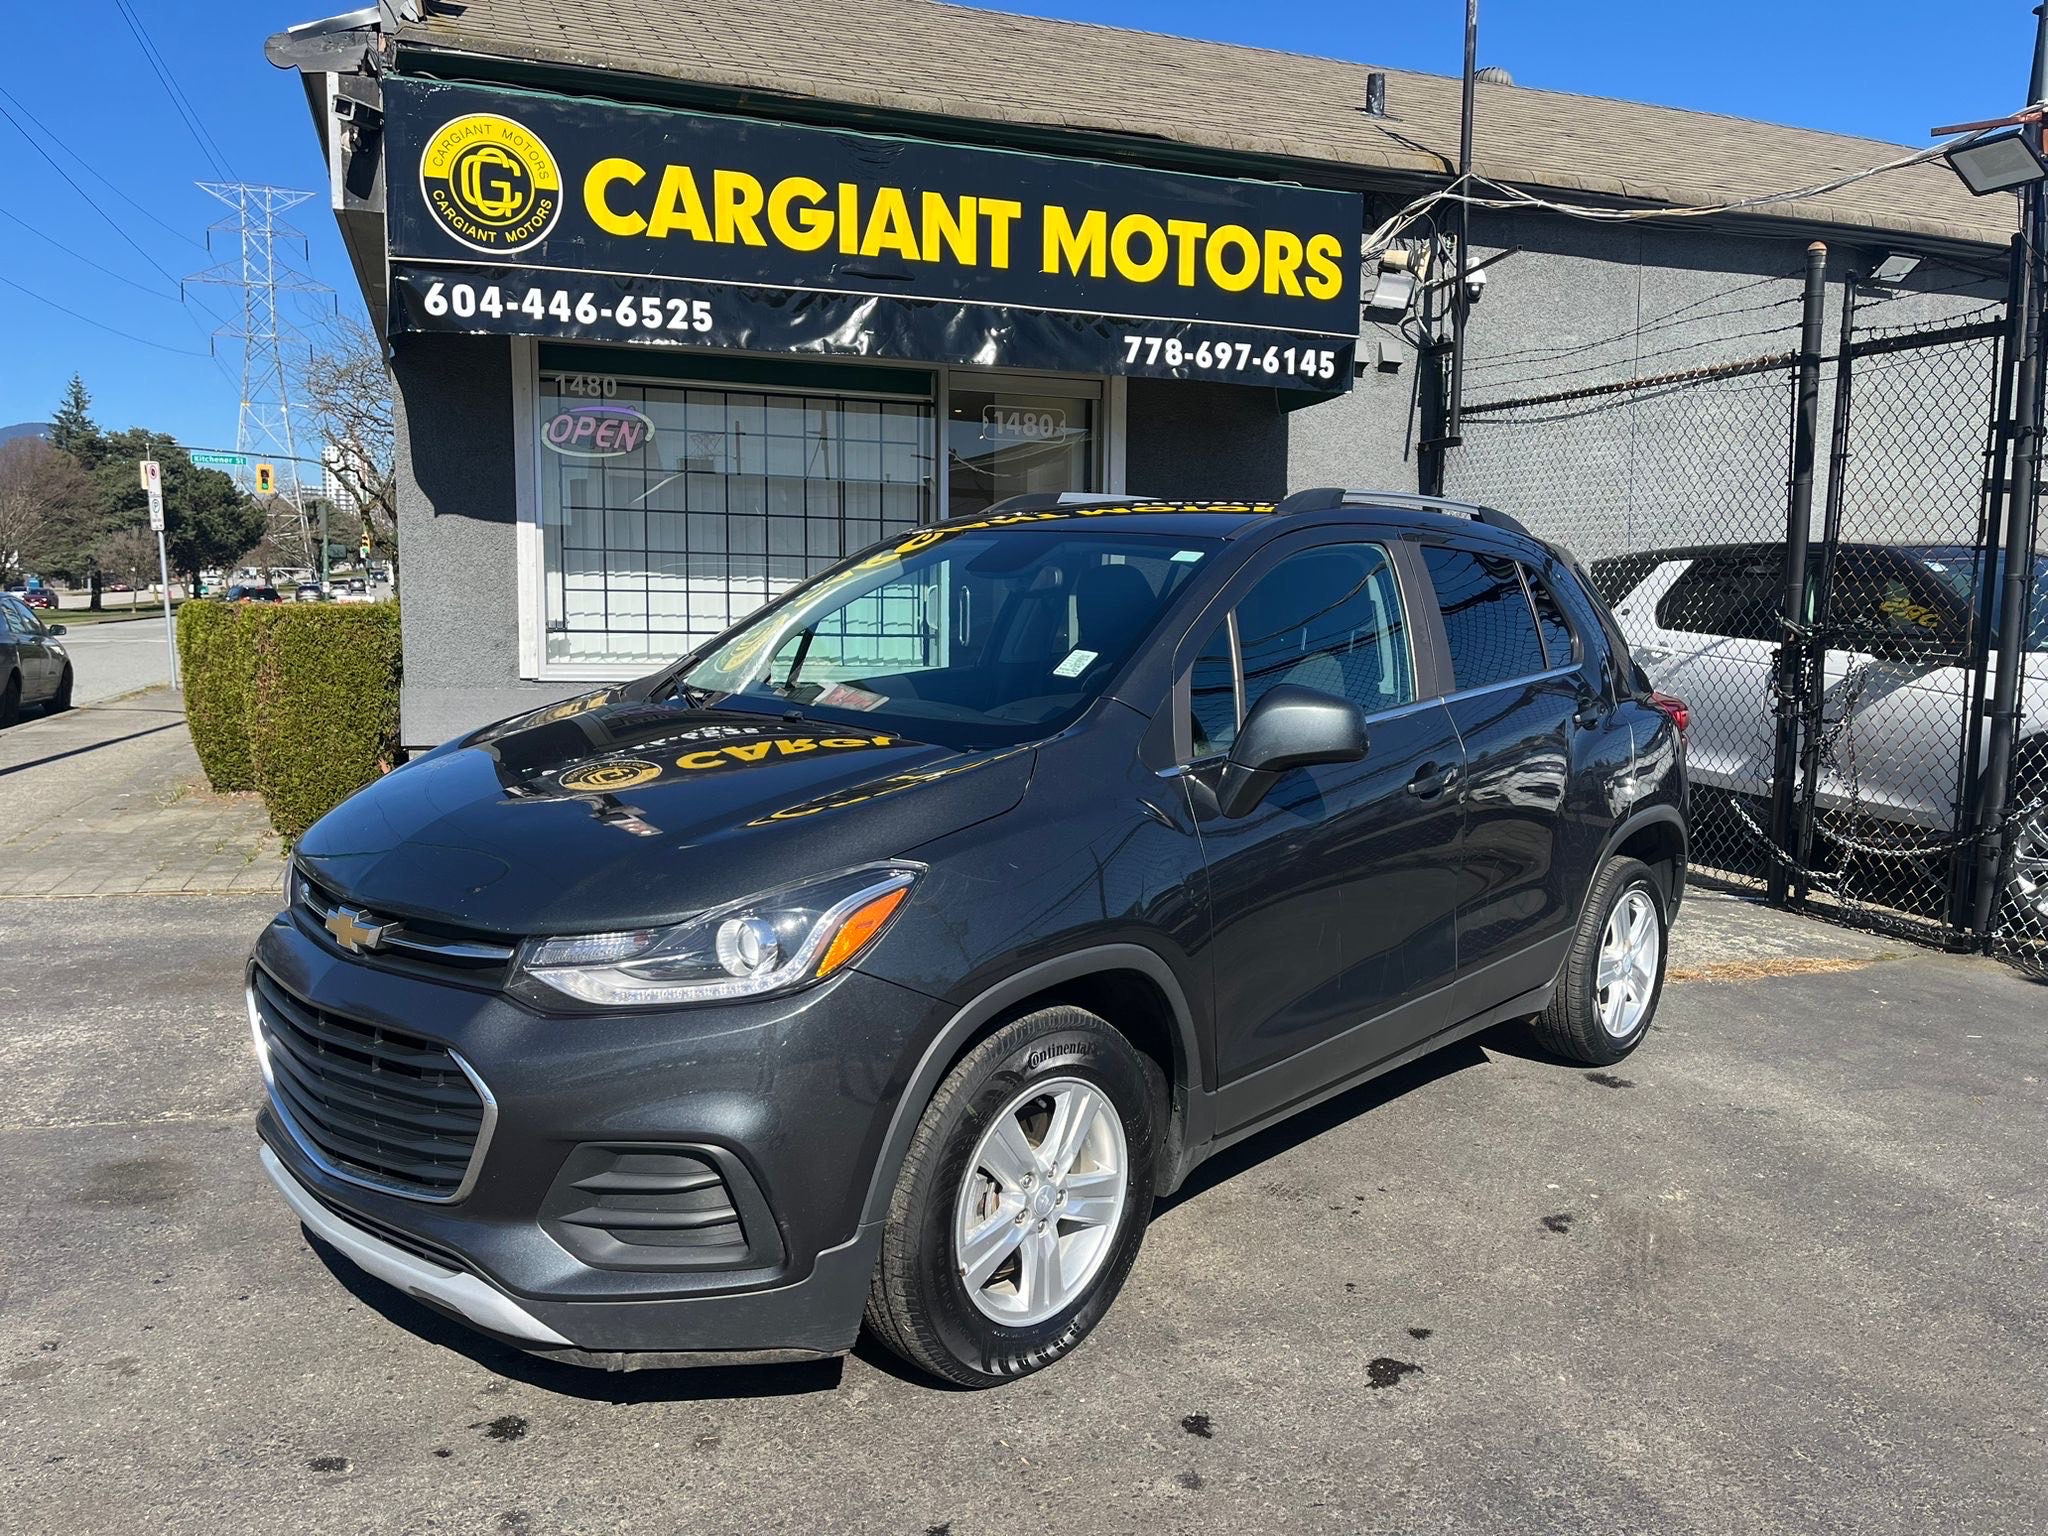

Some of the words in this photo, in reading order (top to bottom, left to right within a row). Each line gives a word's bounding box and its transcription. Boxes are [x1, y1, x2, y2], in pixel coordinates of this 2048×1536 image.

[433, 124, 492, 167] CARGIANT
[501, 128, 550, 181] MOTORS
[433, 190, 497, 243] CARGIANT
[504, 199, 553, 243] MOTORS
[584, 157, 1022, 269] CARGIANT
[1043, 204, 1343, 300] MOTORS
[424, 282, 713, 332] 604-446-6525
[1124, 335, 1335, 379] 778-697-6145
[555, 374, 617, 397] 1480
[549, 414, 642, 452] OPEN
[994, 411, 1054, 438] 1480
[193, 455, 232, 464] Kitchener
[235, 457, 244, 465] St
[1027, 1042, 1094, 1070] Continental
